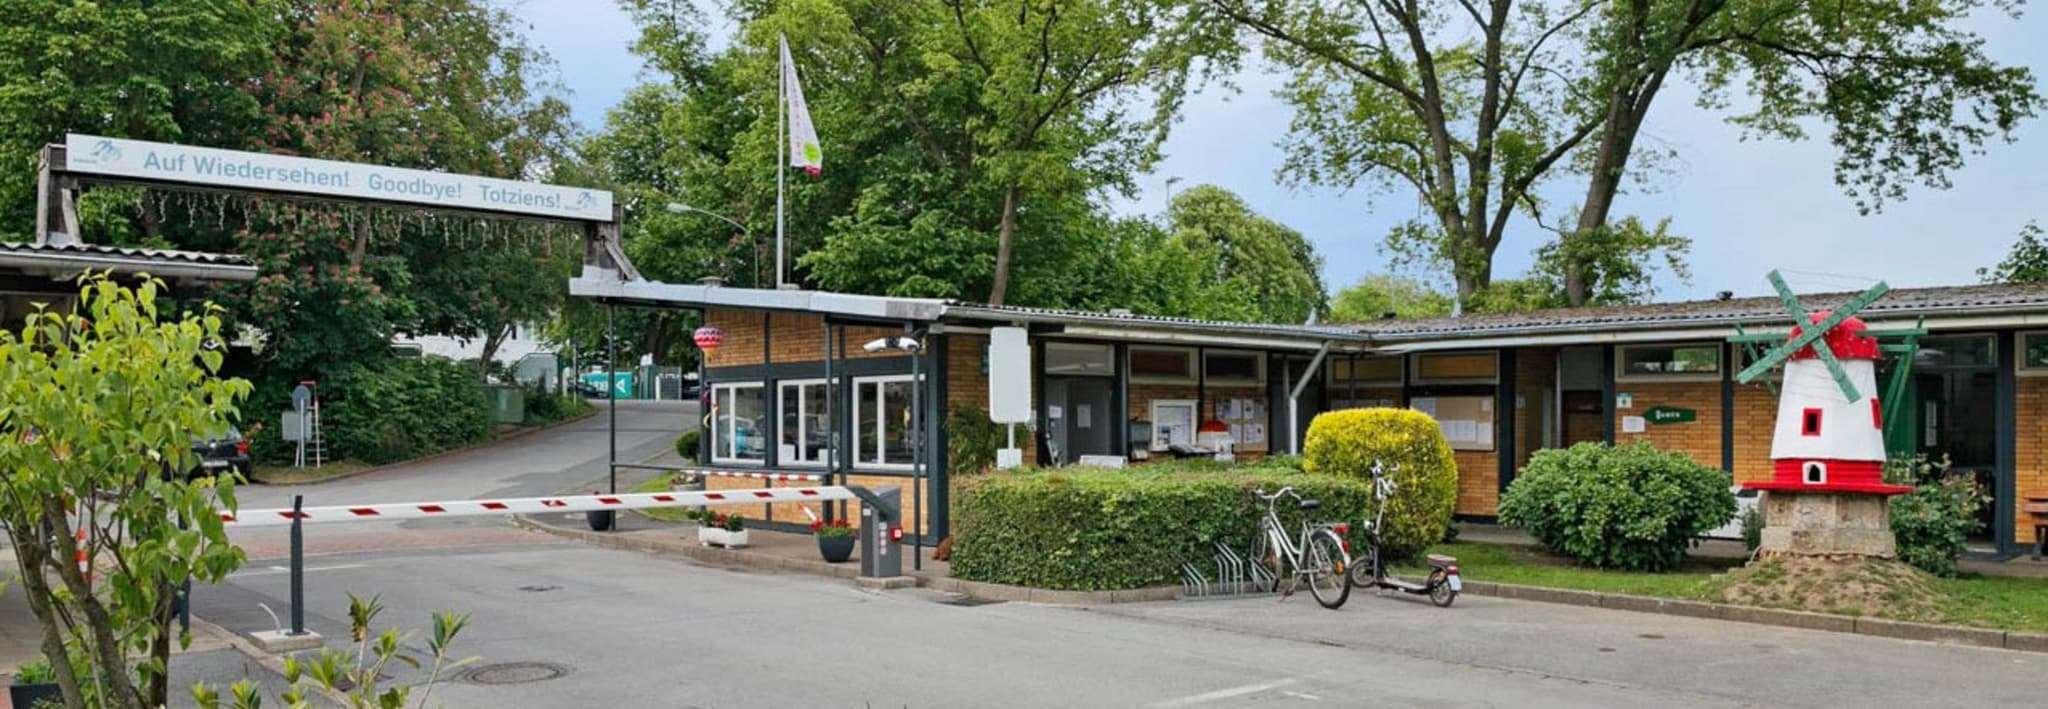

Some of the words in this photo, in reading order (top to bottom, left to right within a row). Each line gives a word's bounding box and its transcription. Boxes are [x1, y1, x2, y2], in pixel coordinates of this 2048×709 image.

[144, 151, 186, 172] Auf
[193, 155, 350, 187] Wiedersehen!
[368, 173, 462, 200] Goodbye!
[480, 185, 561, 208] Totziens!
